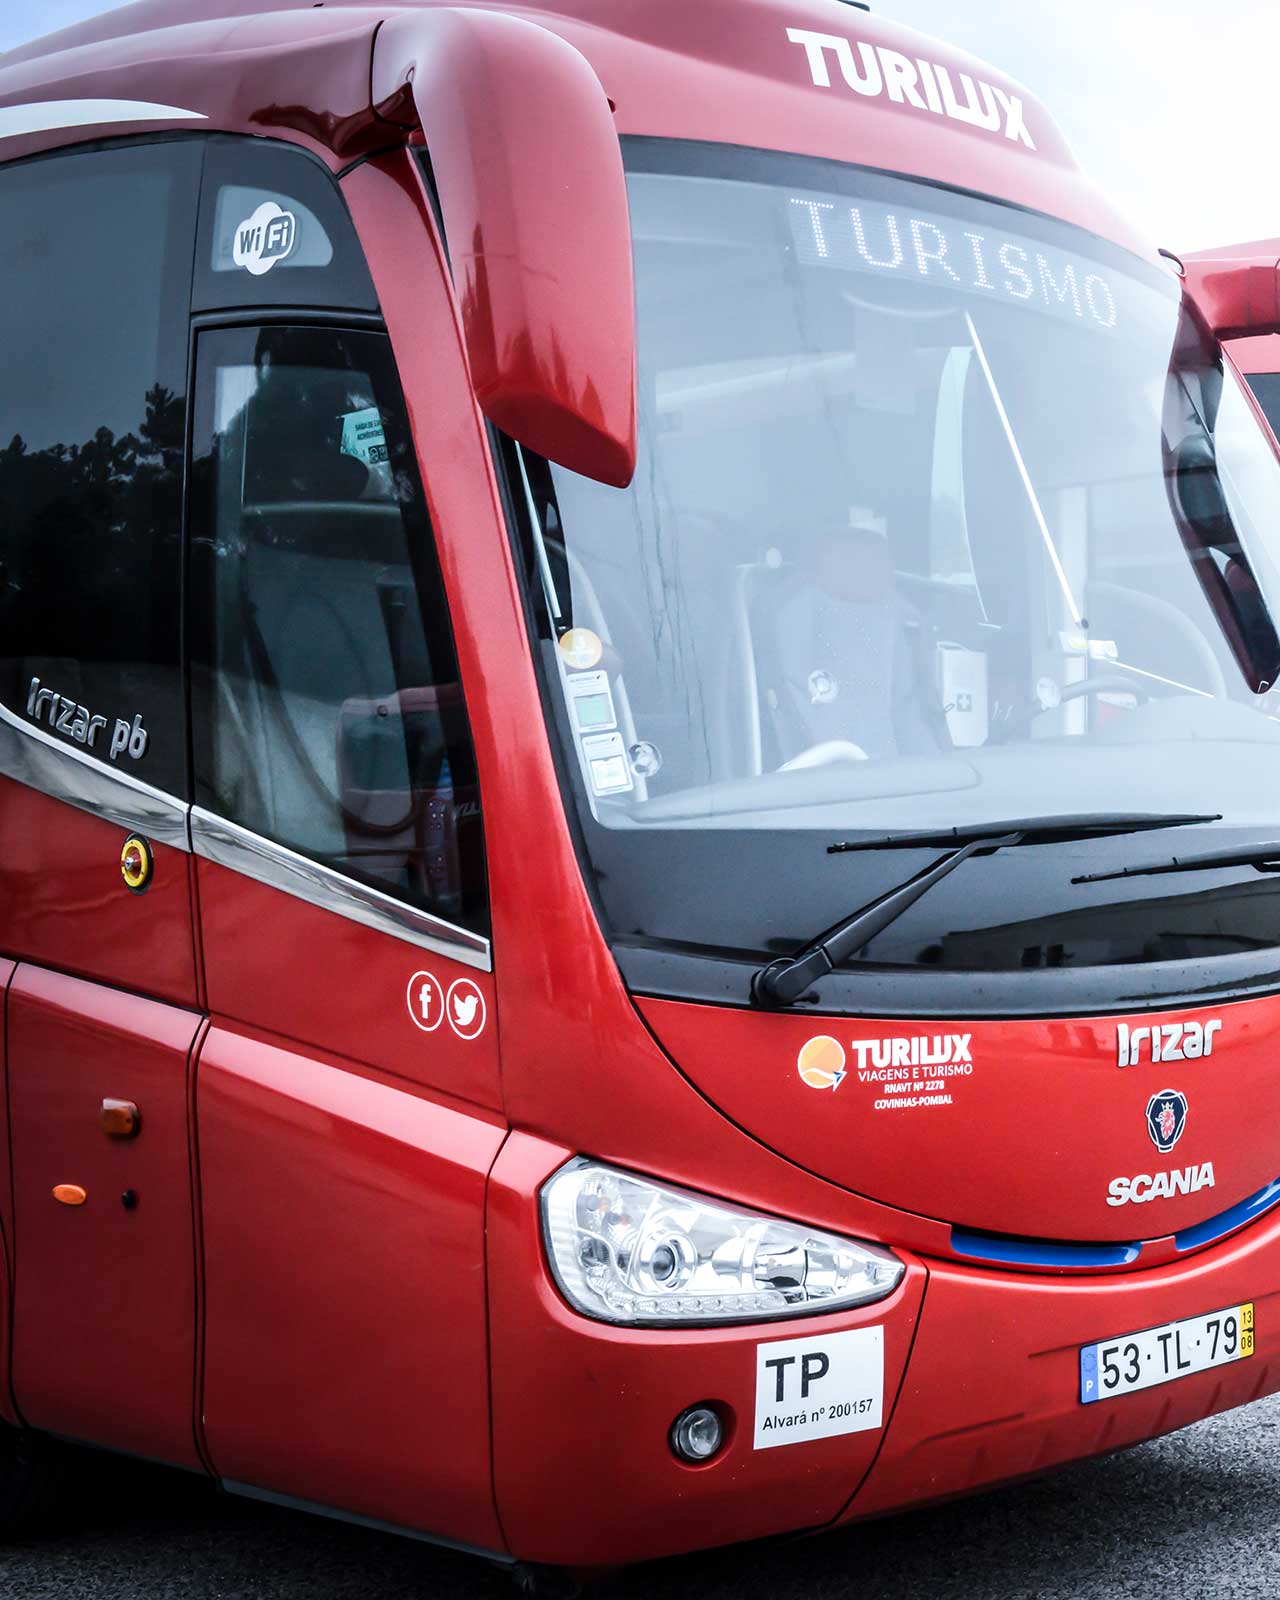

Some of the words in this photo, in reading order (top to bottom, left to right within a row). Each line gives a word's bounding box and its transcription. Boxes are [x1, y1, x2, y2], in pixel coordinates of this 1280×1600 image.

[786, 28, 1037, 151] TURILUX
[790, 198, 1117, 328] TURISMO
[110, 714, 147, 759] pb
[852, 1034, 973, 1069] TURILUX
[858, 1068, 909, 1082] VIAGENS
[912, 1067, 920, 1079] E
[922, 1063, 973, 1078] TURISMO
[884, 1082, 912, 1094] RNAVT
[925, 1080, 945, 1091] 2278
[874, 1095, 953, 1110] COVINHAS-POMBAL
[1106, 1161, 1216, 1207] SCANIA
[1242, 1310, 1252, 1326] 13
[1240, 1334, 1253, 1350] 08
[765, 1352, 829, 1402] TP
[1086, 1380, 1094, 1393] P
[762, 1410, 807, 1430] Alvará
[829, 1399, 873, 1419] 200157
